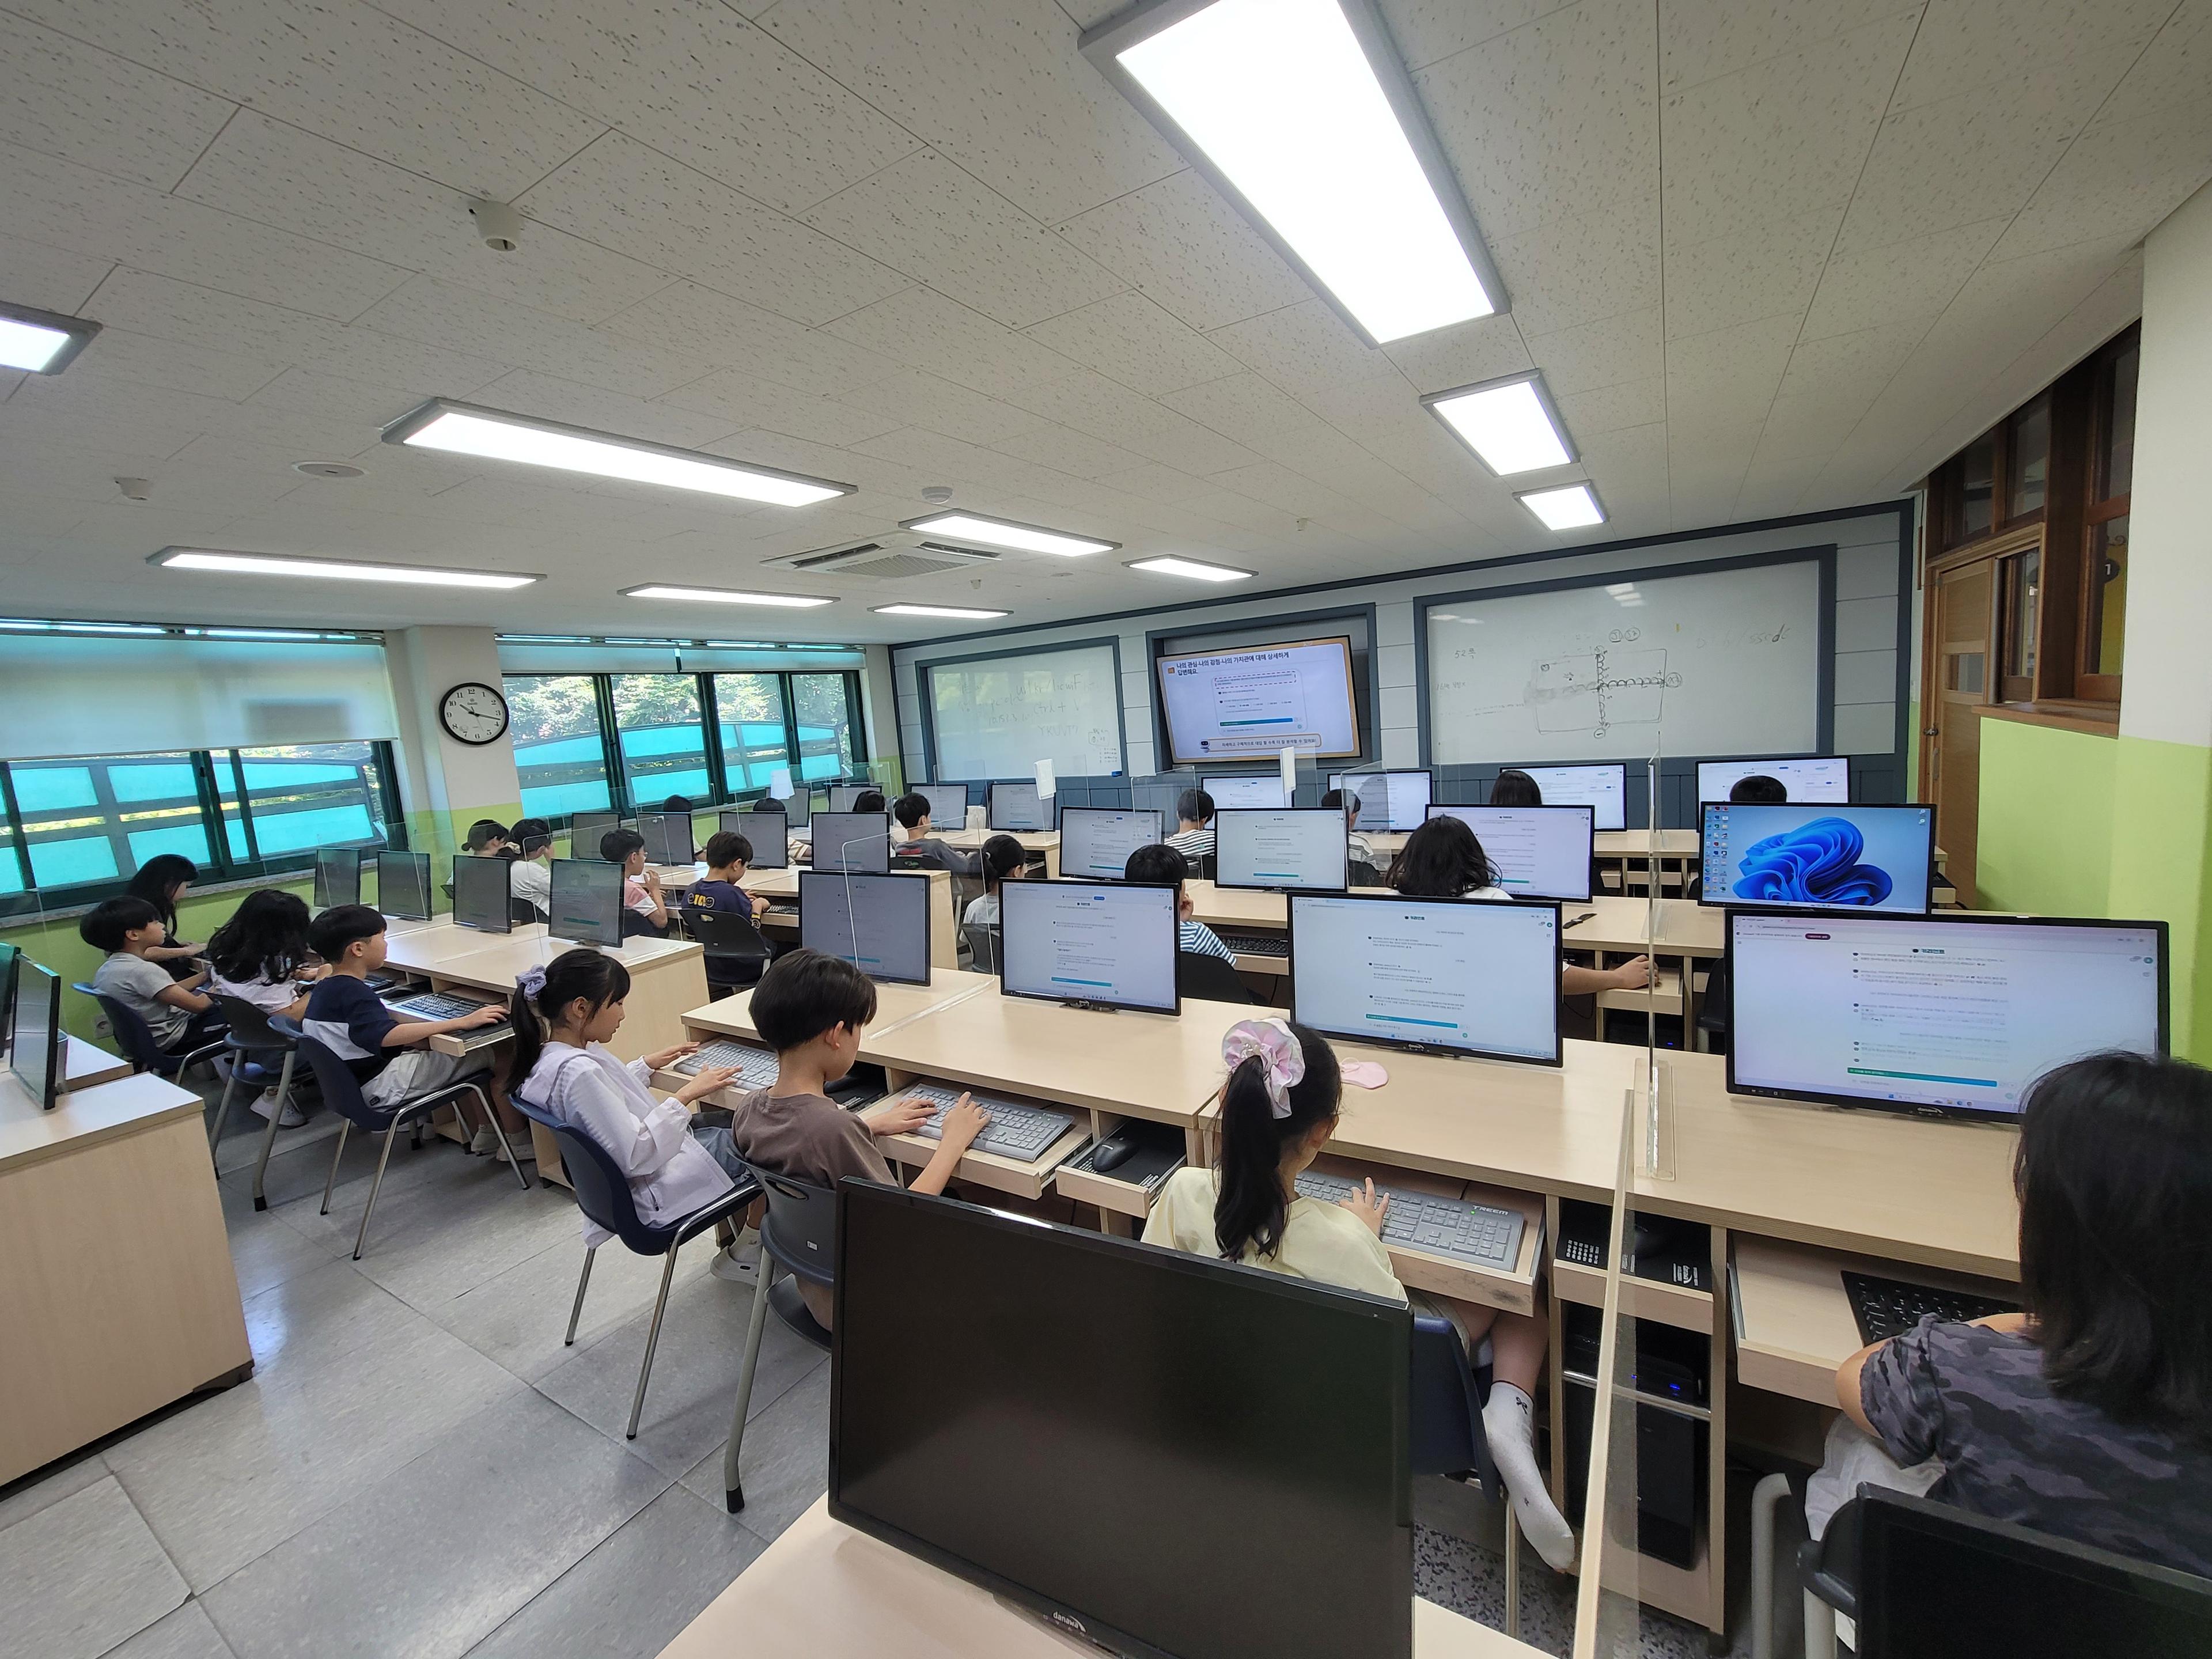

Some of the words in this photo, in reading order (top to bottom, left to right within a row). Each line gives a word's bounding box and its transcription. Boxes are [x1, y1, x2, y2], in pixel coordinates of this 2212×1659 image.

[1233, 655, 1255, 664] 가치관에
[1267, 652, 1289, 660] 상세하게
[1472, 1205, 1508, 1215] TREEM
[1053, 1611, 1078, 1628] danawa
